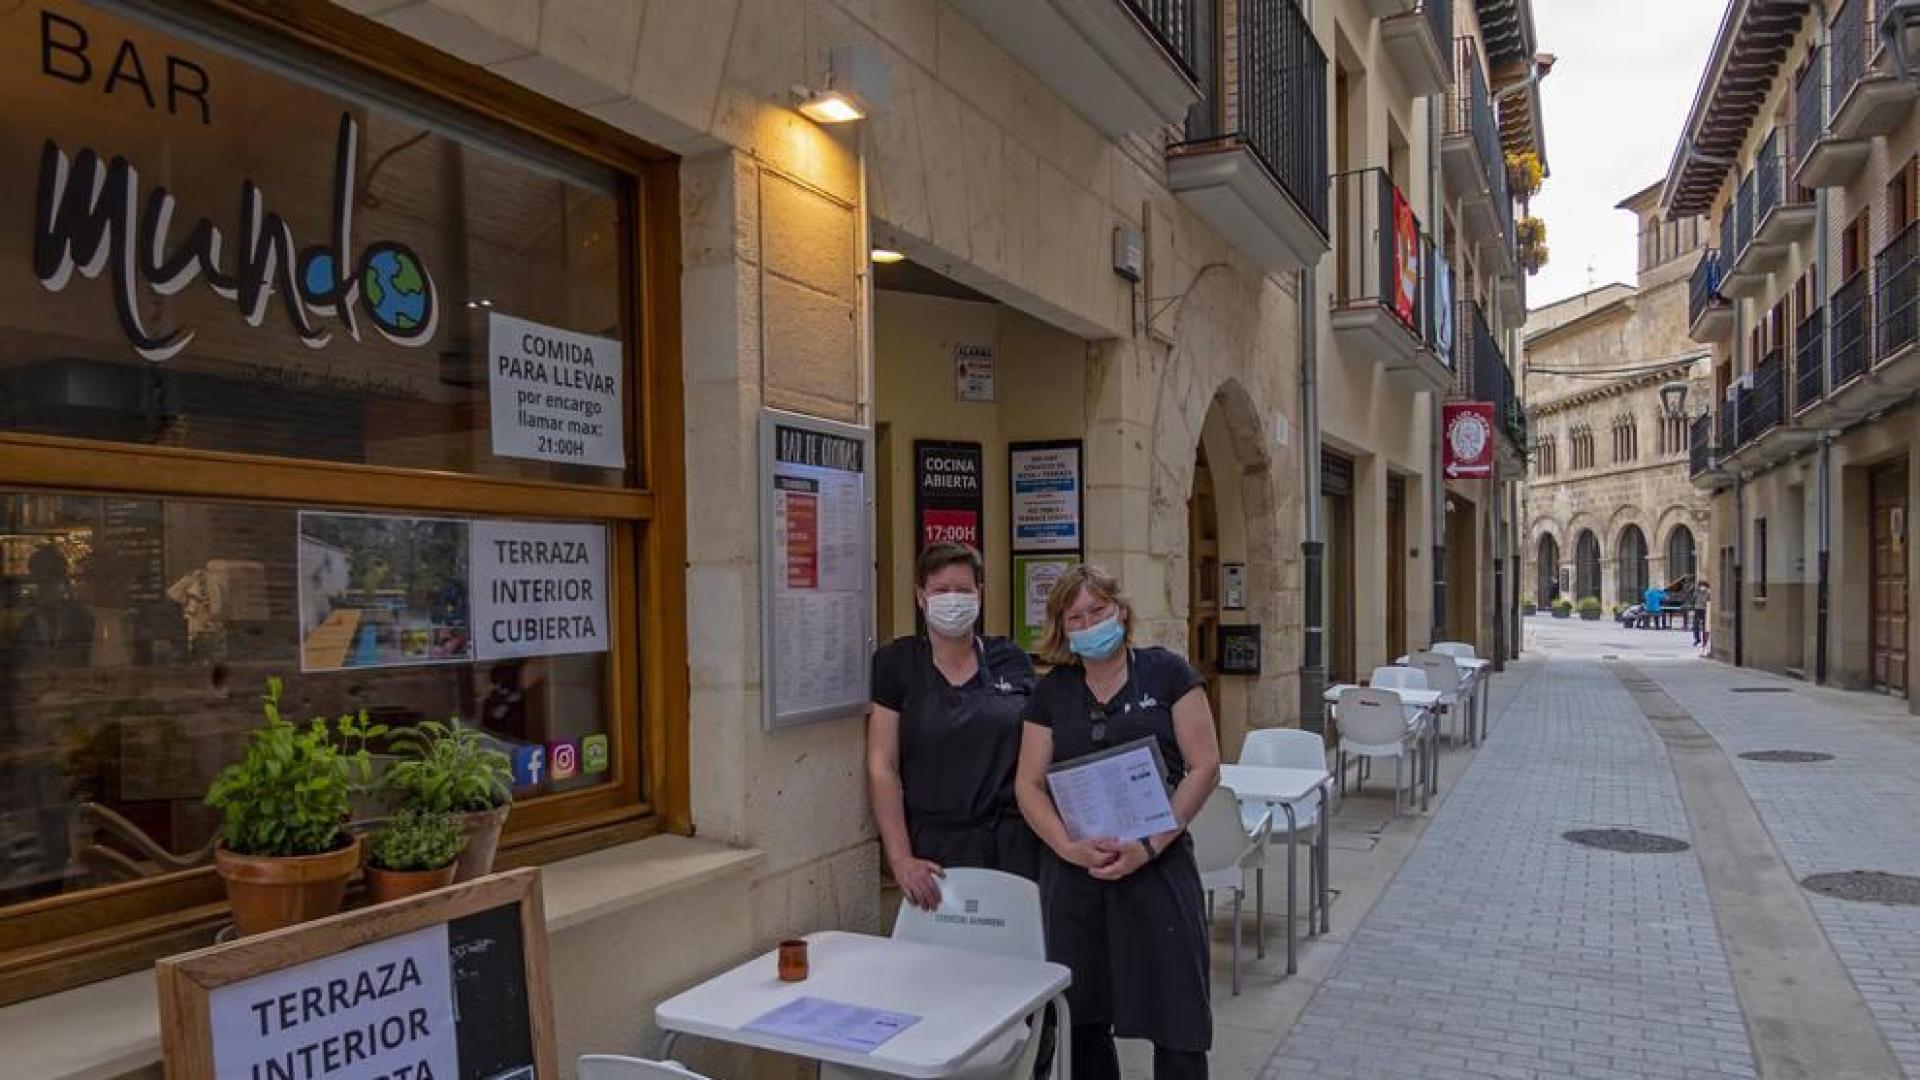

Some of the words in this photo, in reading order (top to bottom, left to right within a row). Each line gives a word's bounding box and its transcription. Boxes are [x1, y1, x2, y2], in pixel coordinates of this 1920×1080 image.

[40, 10, 211, 125] BAR
[521, 333, 594, 367] COMIDA
[498, 356, 547, 383] PARA
[554, 365, 615, 396] LLEVAR
[517, 390, 541, 408] por
[546, 394, 602, 418] encargo
[518, 410, 563, 431] llamar
[568, 420, 602, 436] max:
[538, 435, 585, 457] 21:00H
[926, 457, 975, 473] COCINA
[924, 472, 977, 490] ABIERTA
[926, 525, 975, 541] 17:00H
[493, 540, 589, 564] TERRAZA
[492, 579, 593, 604] INTERIOR
[492, 615, 596, 644] CUBIERTA
[252, 957, 422, 1037] TERRAZA
